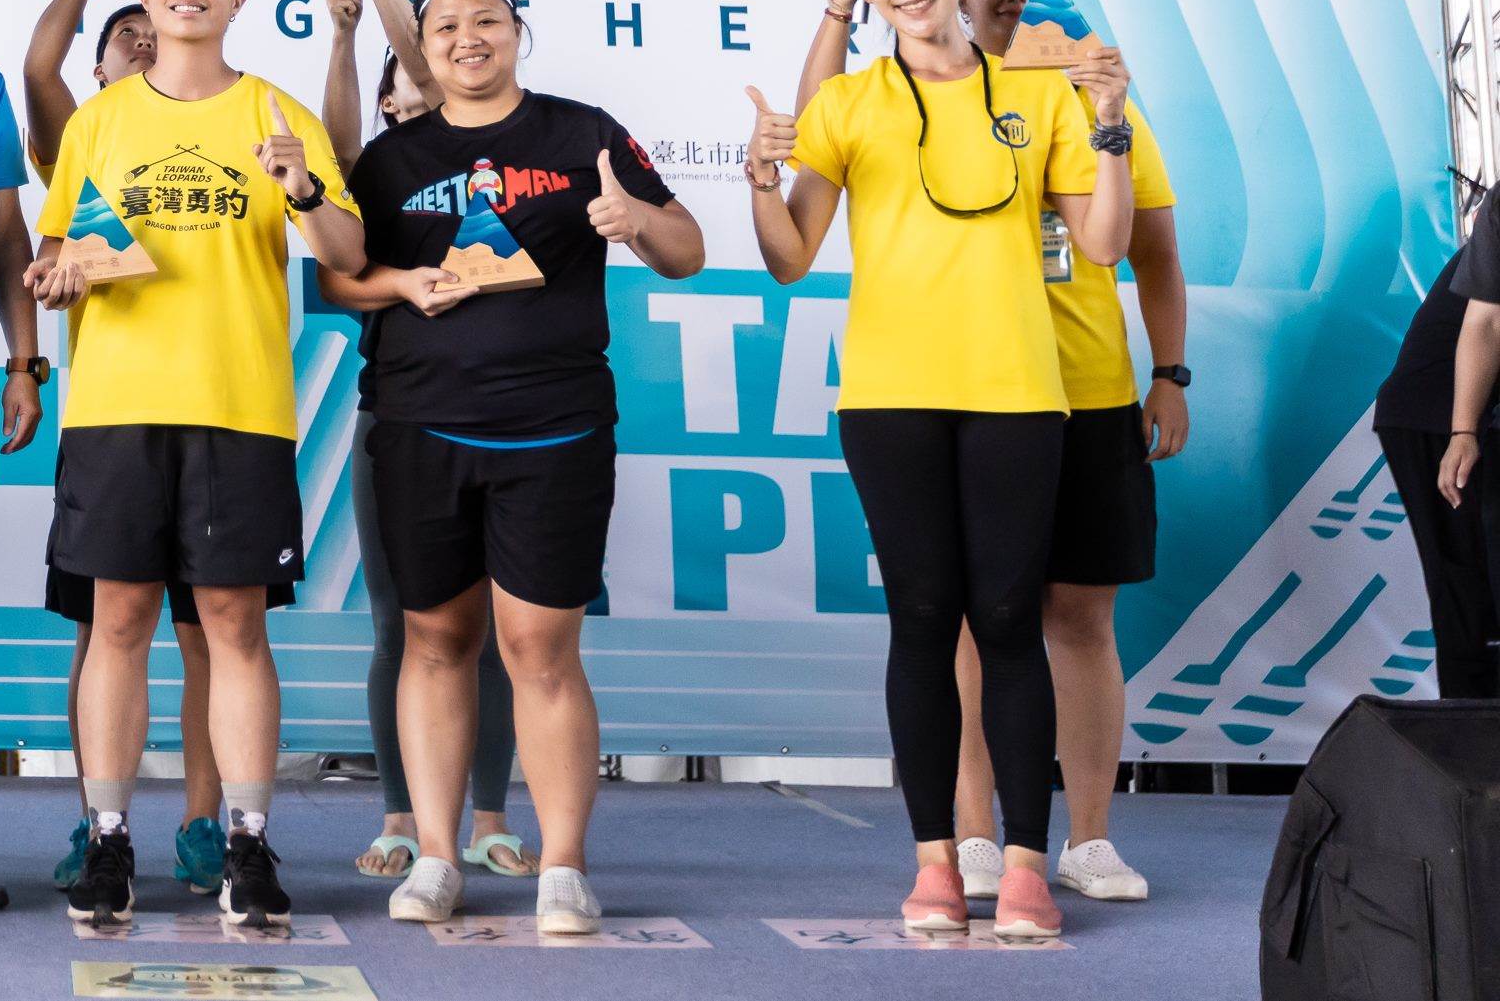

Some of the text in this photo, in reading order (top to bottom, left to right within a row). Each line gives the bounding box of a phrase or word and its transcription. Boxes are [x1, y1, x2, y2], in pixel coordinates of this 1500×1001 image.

[163, 165, 206, 174] TAIWAN
[155, 173, 213, 183] LEOPARDS
[660, 170, 710, 183] epartment
[712, 171, 723, 182] of
[401, 165, 571, 217] CHEST MAN
[119, 185, 250, 220] 臺灣勇豹
[145, 219, 221, 232] DRAGON BOAT CLUB
